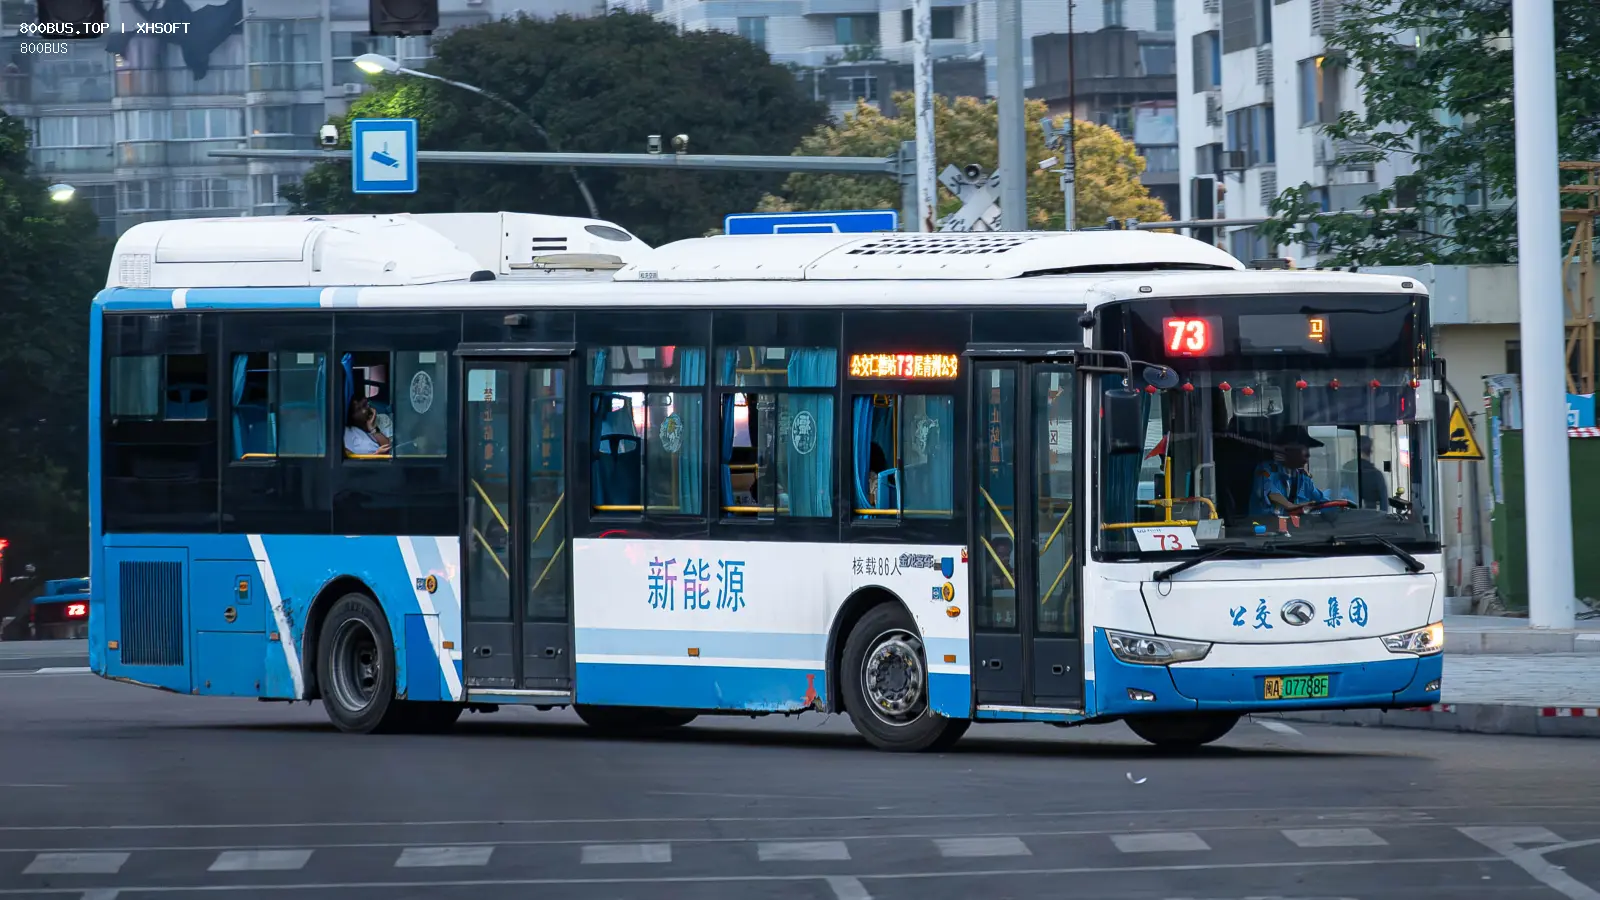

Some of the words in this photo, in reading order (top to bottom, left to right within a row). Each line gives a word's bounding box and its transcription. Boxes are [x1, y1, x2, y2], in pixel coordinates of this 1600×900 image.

[1168, 320, 1205, 350] 73
[1153, 534, 1183, 551] 73
[852, 557, 902, 576] 核载86人
[647, 556, 746, 613] 新能源
[1229, 598, 1274, 630] 公交
[1323, 596, 1369, 629] 集团
